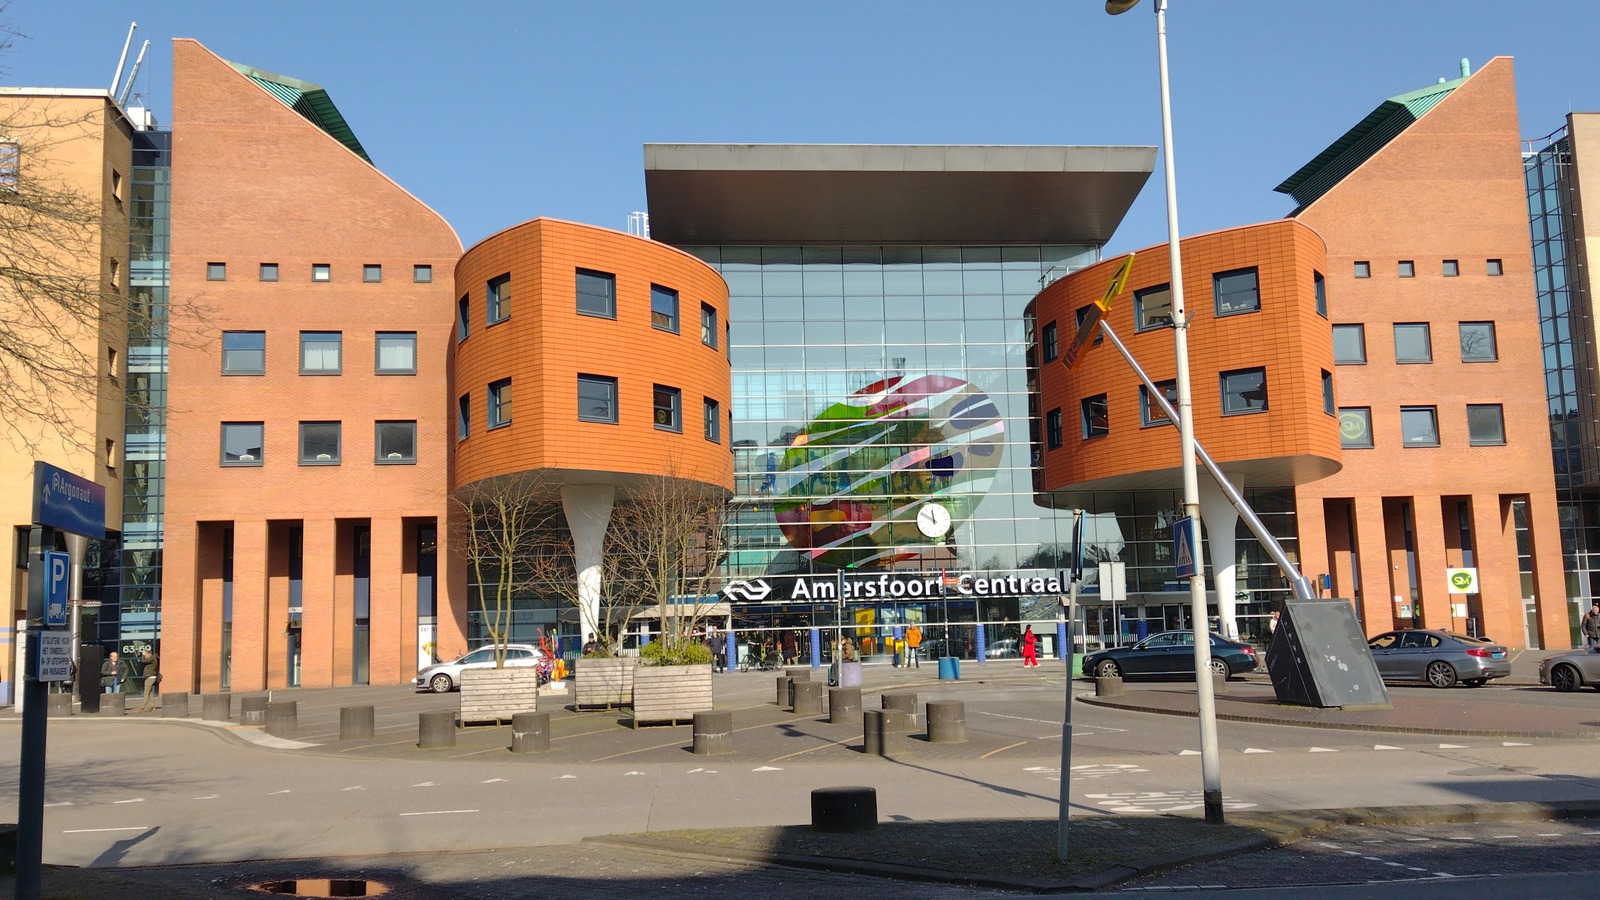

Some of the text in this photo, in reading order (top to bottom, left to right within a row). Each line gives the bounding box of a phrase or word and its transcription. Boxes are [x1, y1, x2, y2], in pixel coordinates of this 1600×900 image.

[60, 477, 90, 503] Argonaut
[52, 558, 65, 594] P
[1454, 576, 1470, 585] S2M
[791, 571, 1069, 600] Amersfoort Centraal
[62, 636, 70, 645] VOOR
[122, 644, 152, 653] 63-69
